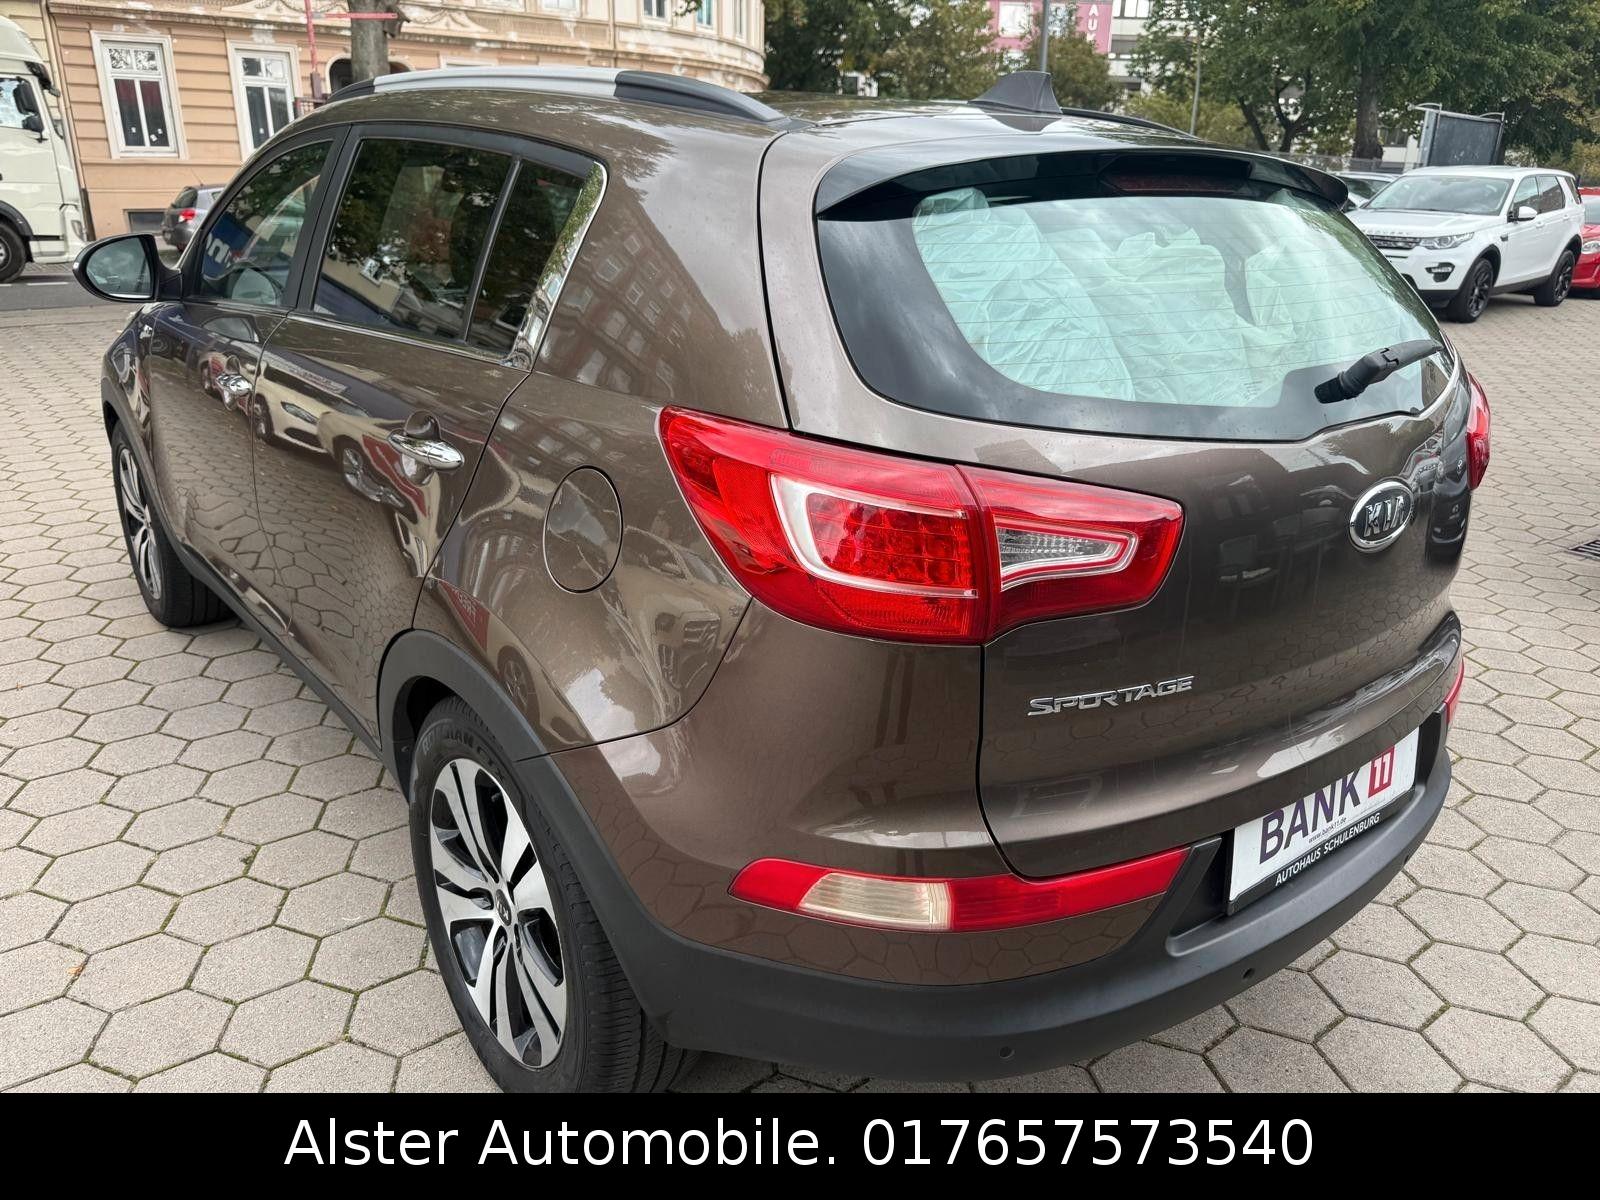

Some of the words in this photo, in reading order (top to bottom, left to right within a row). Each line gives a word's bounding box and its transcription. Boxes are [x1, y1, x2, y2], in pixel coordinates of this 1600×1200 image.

[1364, 495, 1405, 537] KIA
[1028, 675, 1195, 716] SPORTAGE
[1259, 768, 1361, 865] BANK
[1308, 817, 1347, 843] www.bank11.de
[1275, 848, 1321, 886] AUTOHAUS
[1323, 812, 1381, 854] SCHULENBURG
